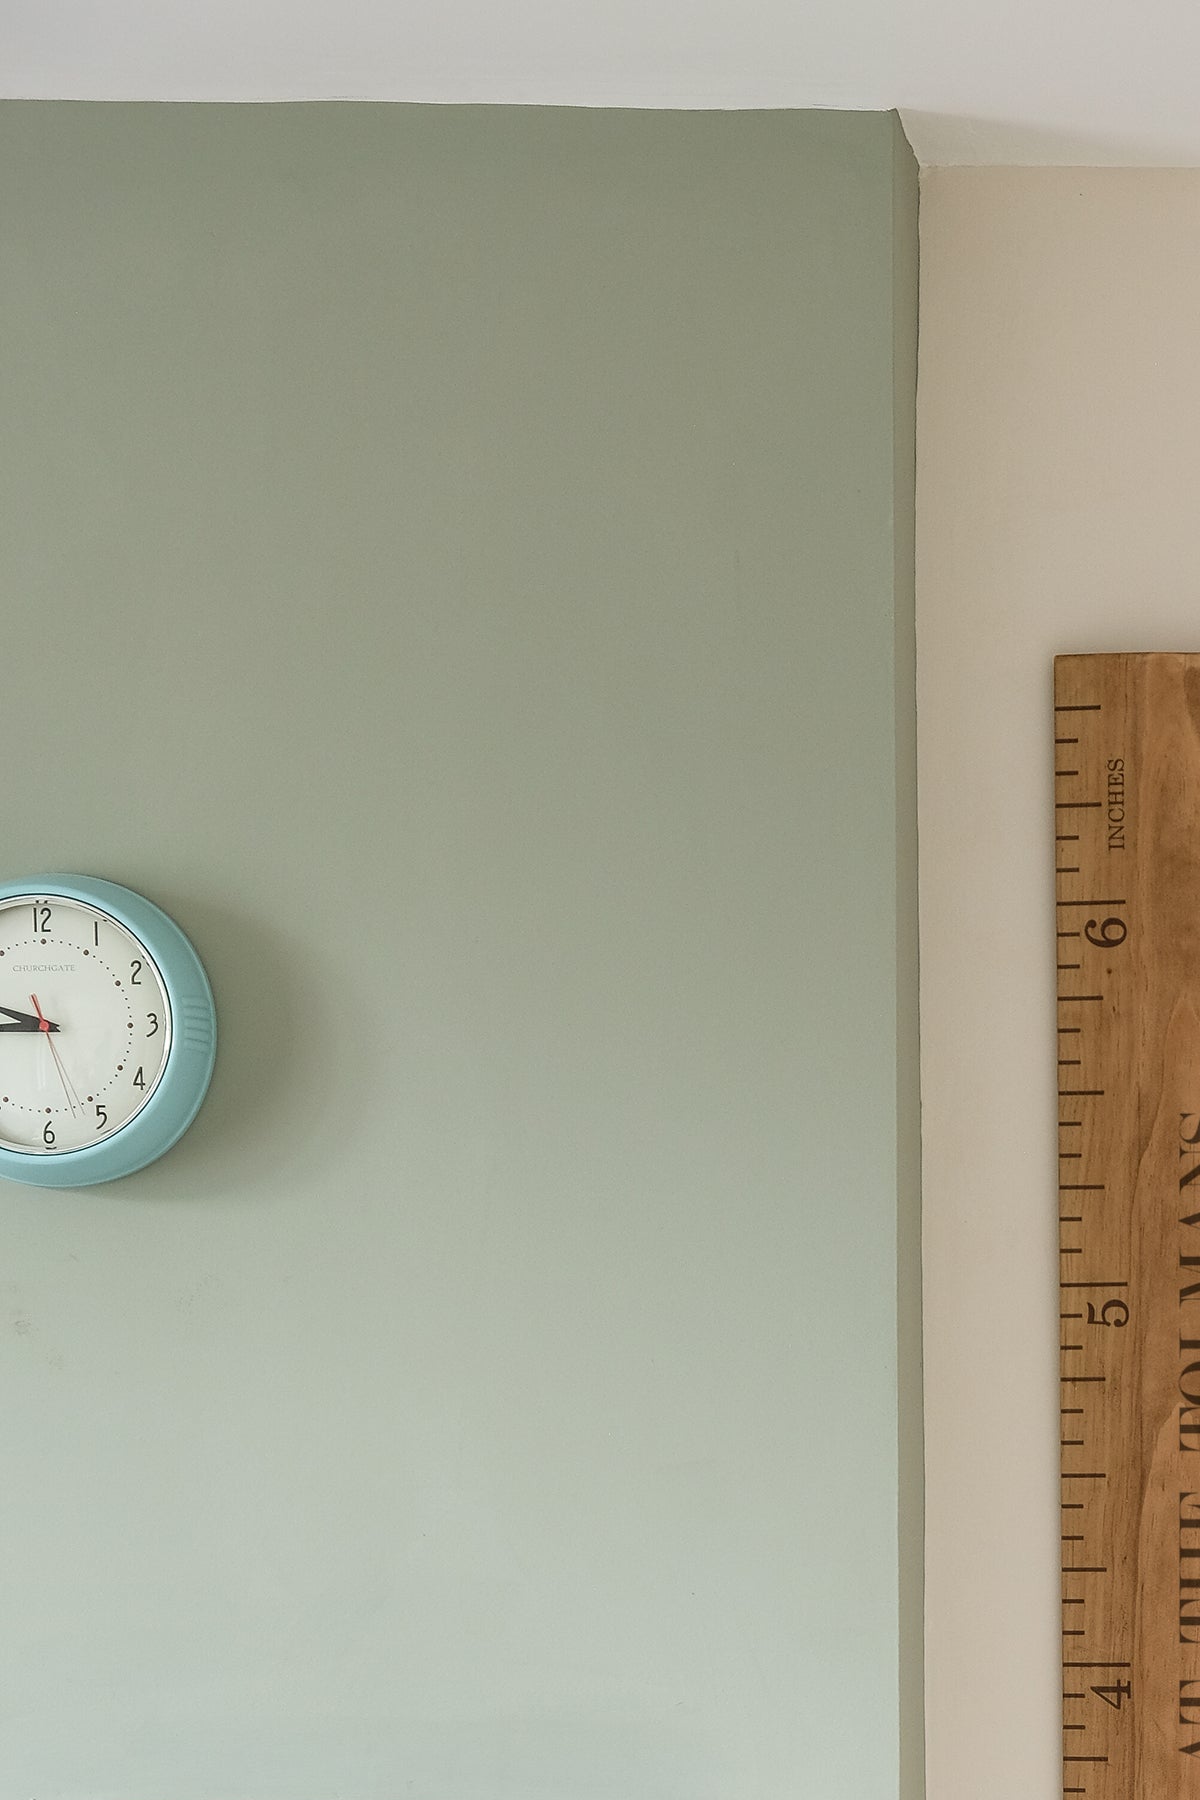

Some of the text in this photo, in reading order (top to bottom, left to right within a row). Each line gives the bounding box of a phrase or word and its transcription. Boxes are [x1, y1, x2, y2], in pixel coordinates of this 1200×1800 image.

[1108, 758, 1124, 850] INCHES
[33, 907, 51, 932] 12
[95, 921, 98, 946] 1
[1085, 917, 1127, 948] 6
[12, 964, 76, 972] CHURCHGATE
[130, 961, 142, 985] 2
[146, 1013, 158, 1037] 3
[133, 1066, 145, 1090] 4
[96, 1105, 107, 1129] 5
[43, 1121, 54, 1144] 6
[1087, 1299, 1129, 1327] 5
[1090, 1679, 1131, 1710] 4
